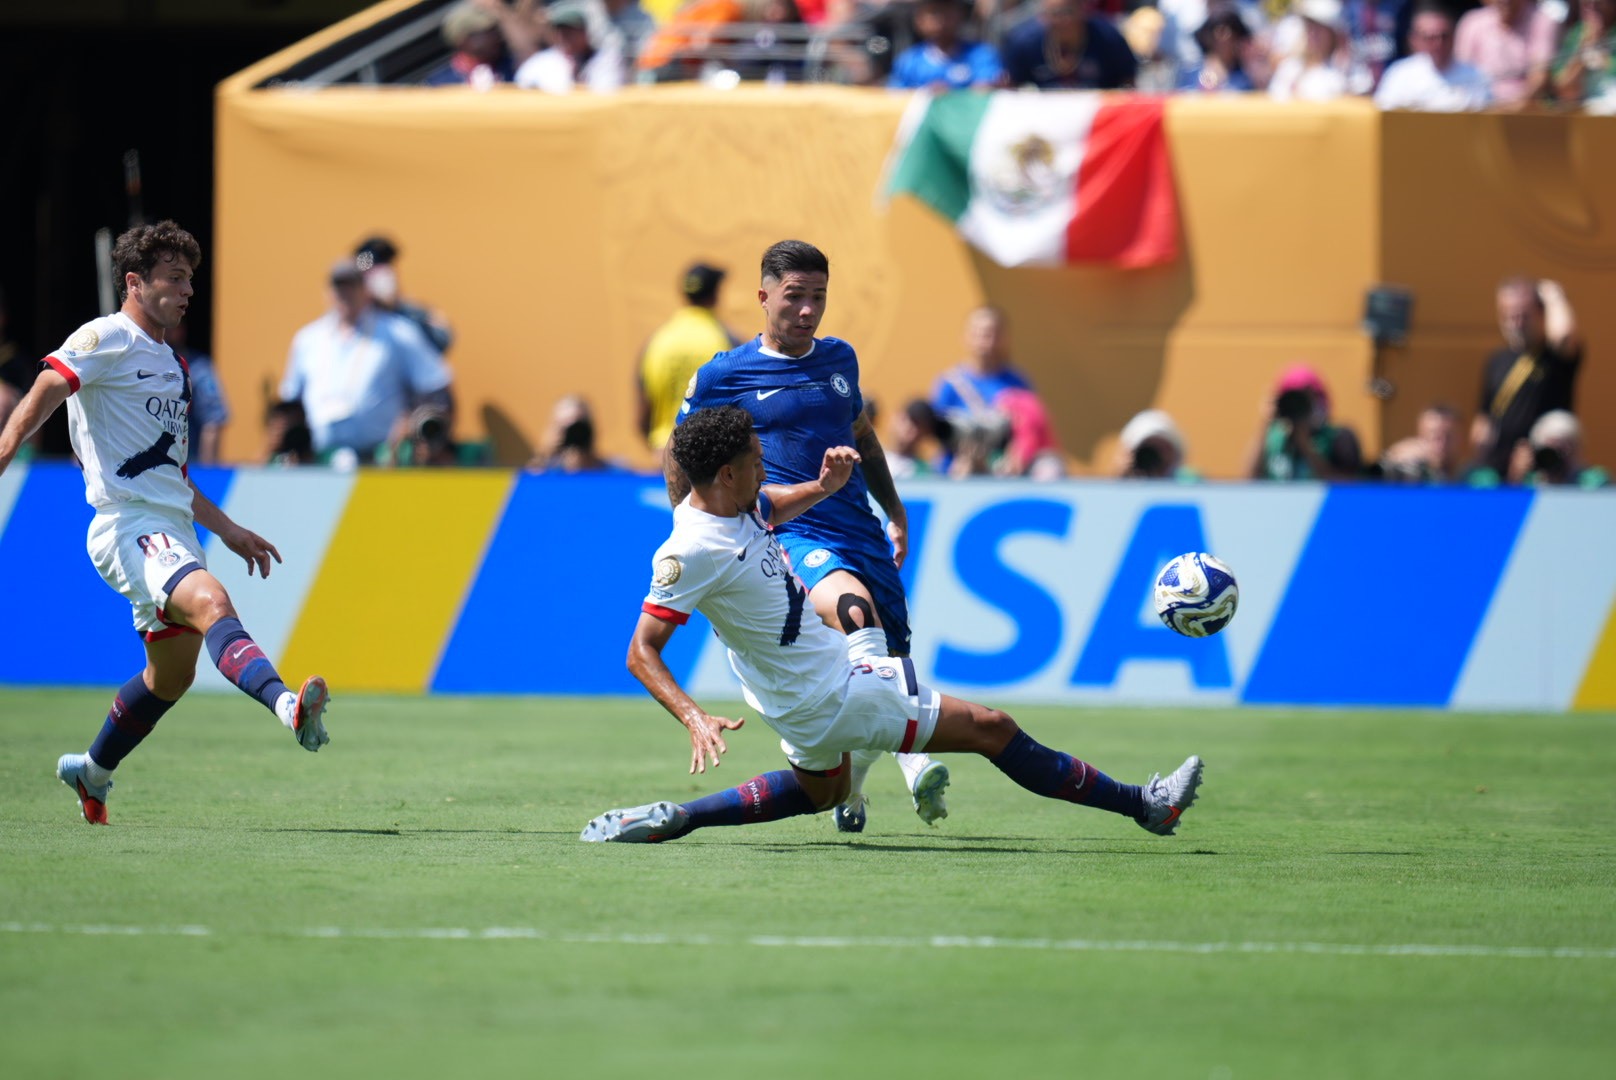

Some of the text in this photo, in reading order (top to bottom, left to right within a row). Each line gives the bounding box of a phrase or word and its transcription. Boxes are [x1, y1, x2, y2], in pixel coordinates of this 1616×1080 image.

[145, 396, 188, 423] QATA
[760, 536, 780, 578] QAT
[882, 497, 1233, 688] SA
